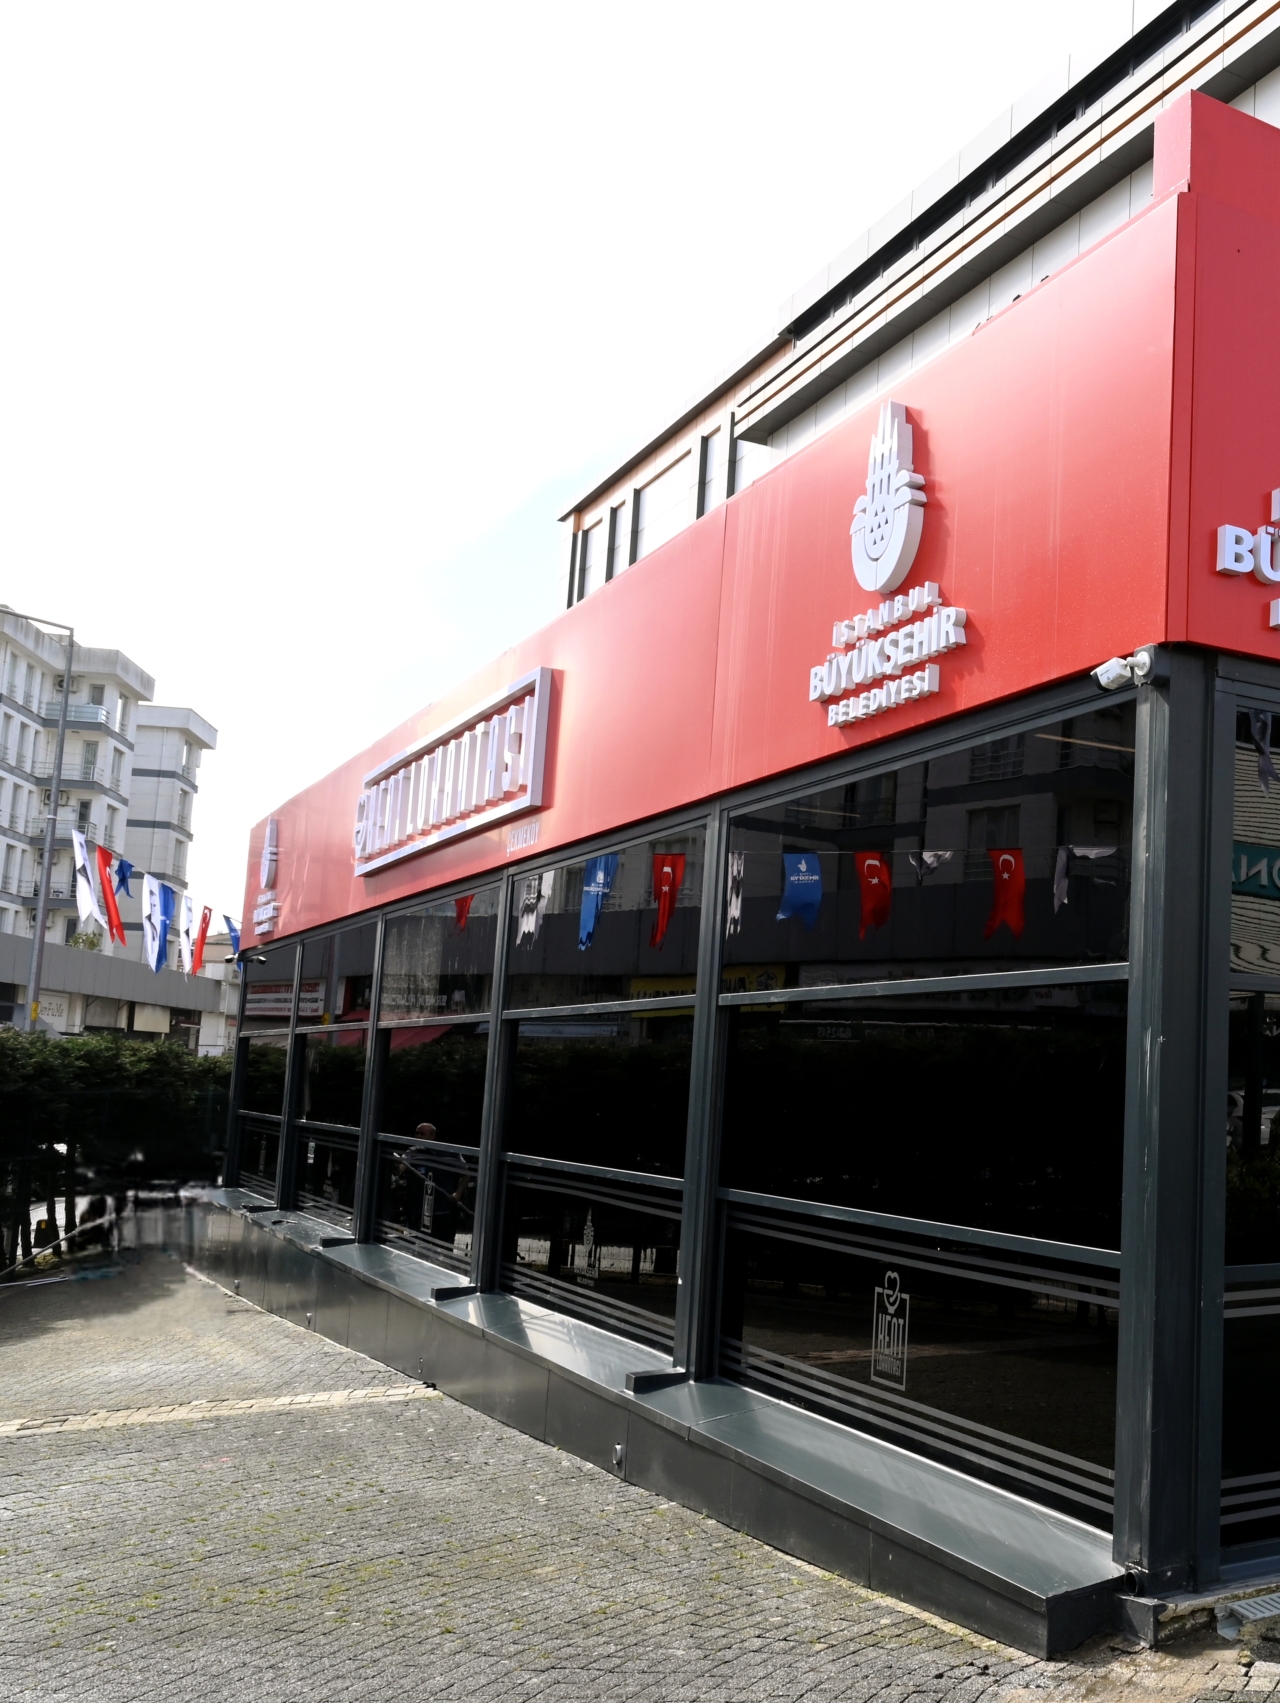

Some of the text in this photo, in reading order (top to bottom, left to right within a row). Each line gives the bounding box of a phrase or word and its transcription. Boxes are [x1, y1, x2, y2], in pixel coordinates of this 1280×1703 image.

[832, 581, 942, 648] İSTANBUL
[809, 605, 967, 702] BÜYÜKŞEHİR
[828, 663, 940, 727] BELEDİYESİ
[406, 696, 535, 835] LOKANTASI
[878, 1313, 904, 1358] KENT
